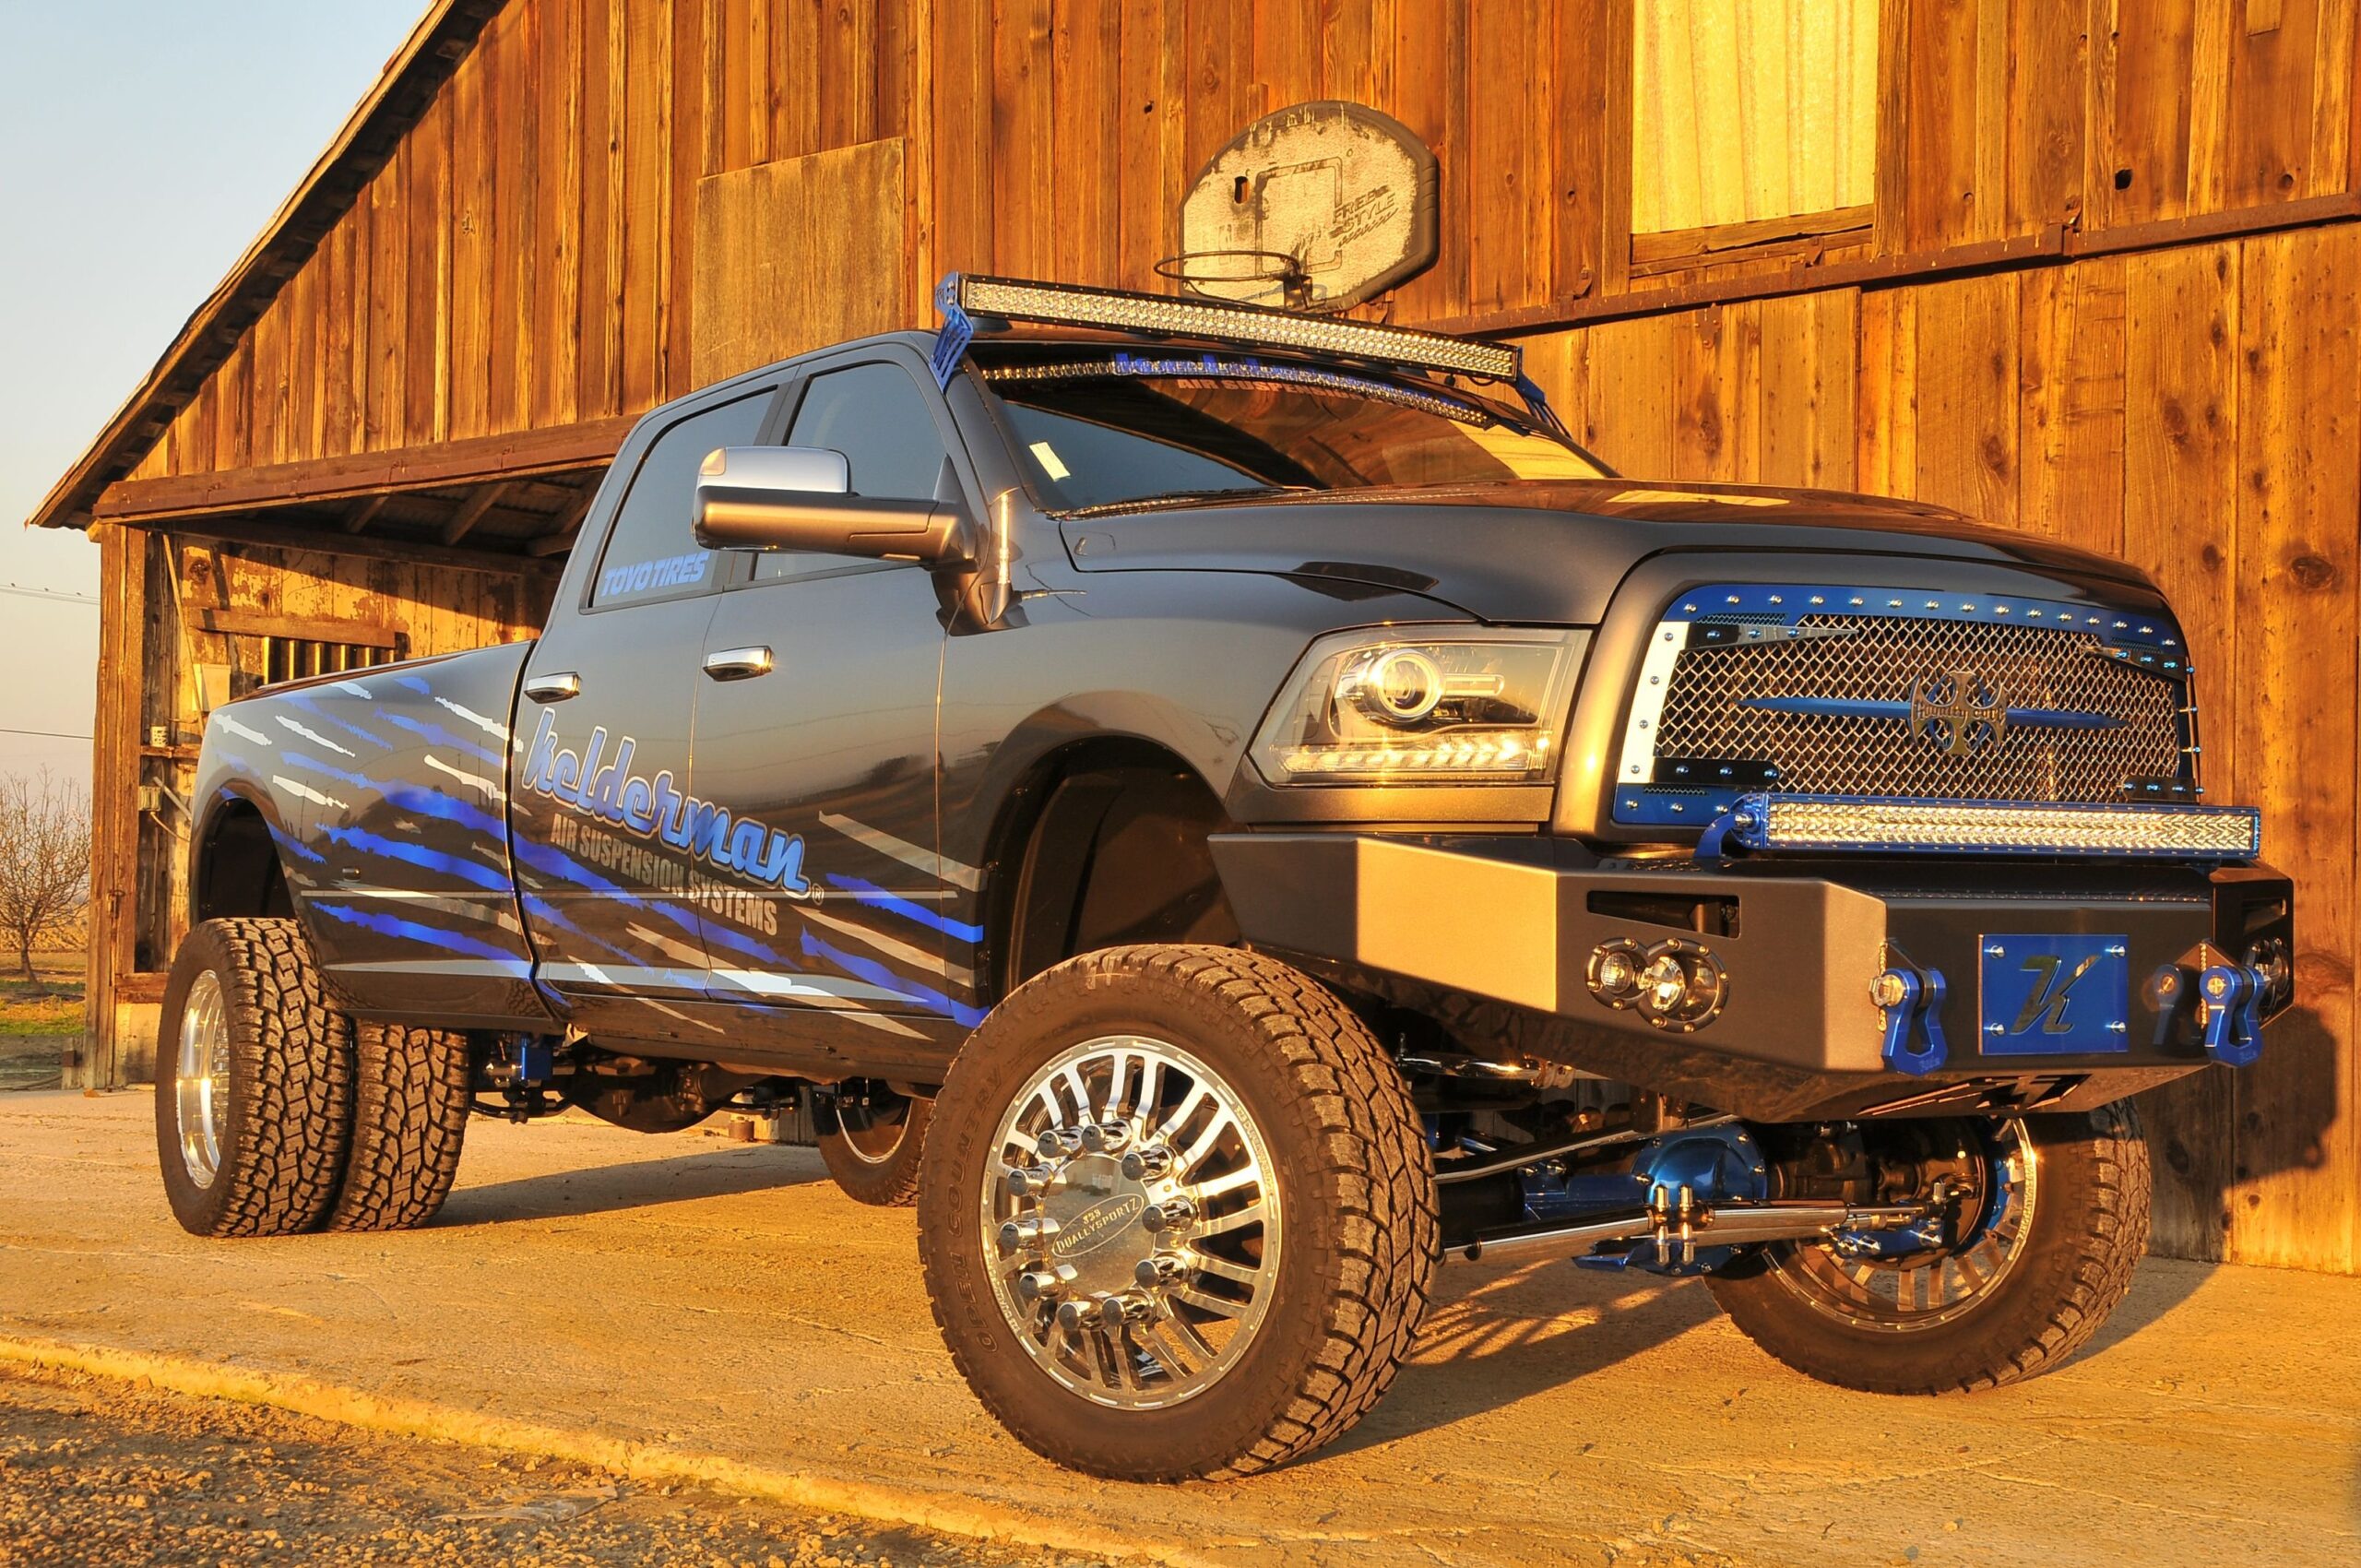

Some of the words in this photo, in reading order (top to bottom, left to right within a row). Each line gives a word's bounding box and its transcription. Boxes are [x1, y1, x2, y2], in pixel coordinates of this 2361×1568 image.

[1177, 379, 1219, 389] AIR
[601, 561, 653, 598] TOYO
[650, 551, 711, 588] TIRES
[522, 707, 811, 899] kelderman
[551, 813, 577, 853] AIR
[579, 825, 685, 899] SUSPENSION
[687, 870, 778, 936] SYSTEMS
[1056, 1197, 1140, 1253] DUALLYSPORTZ
[950, 1252, 998, 1352] OPEN
